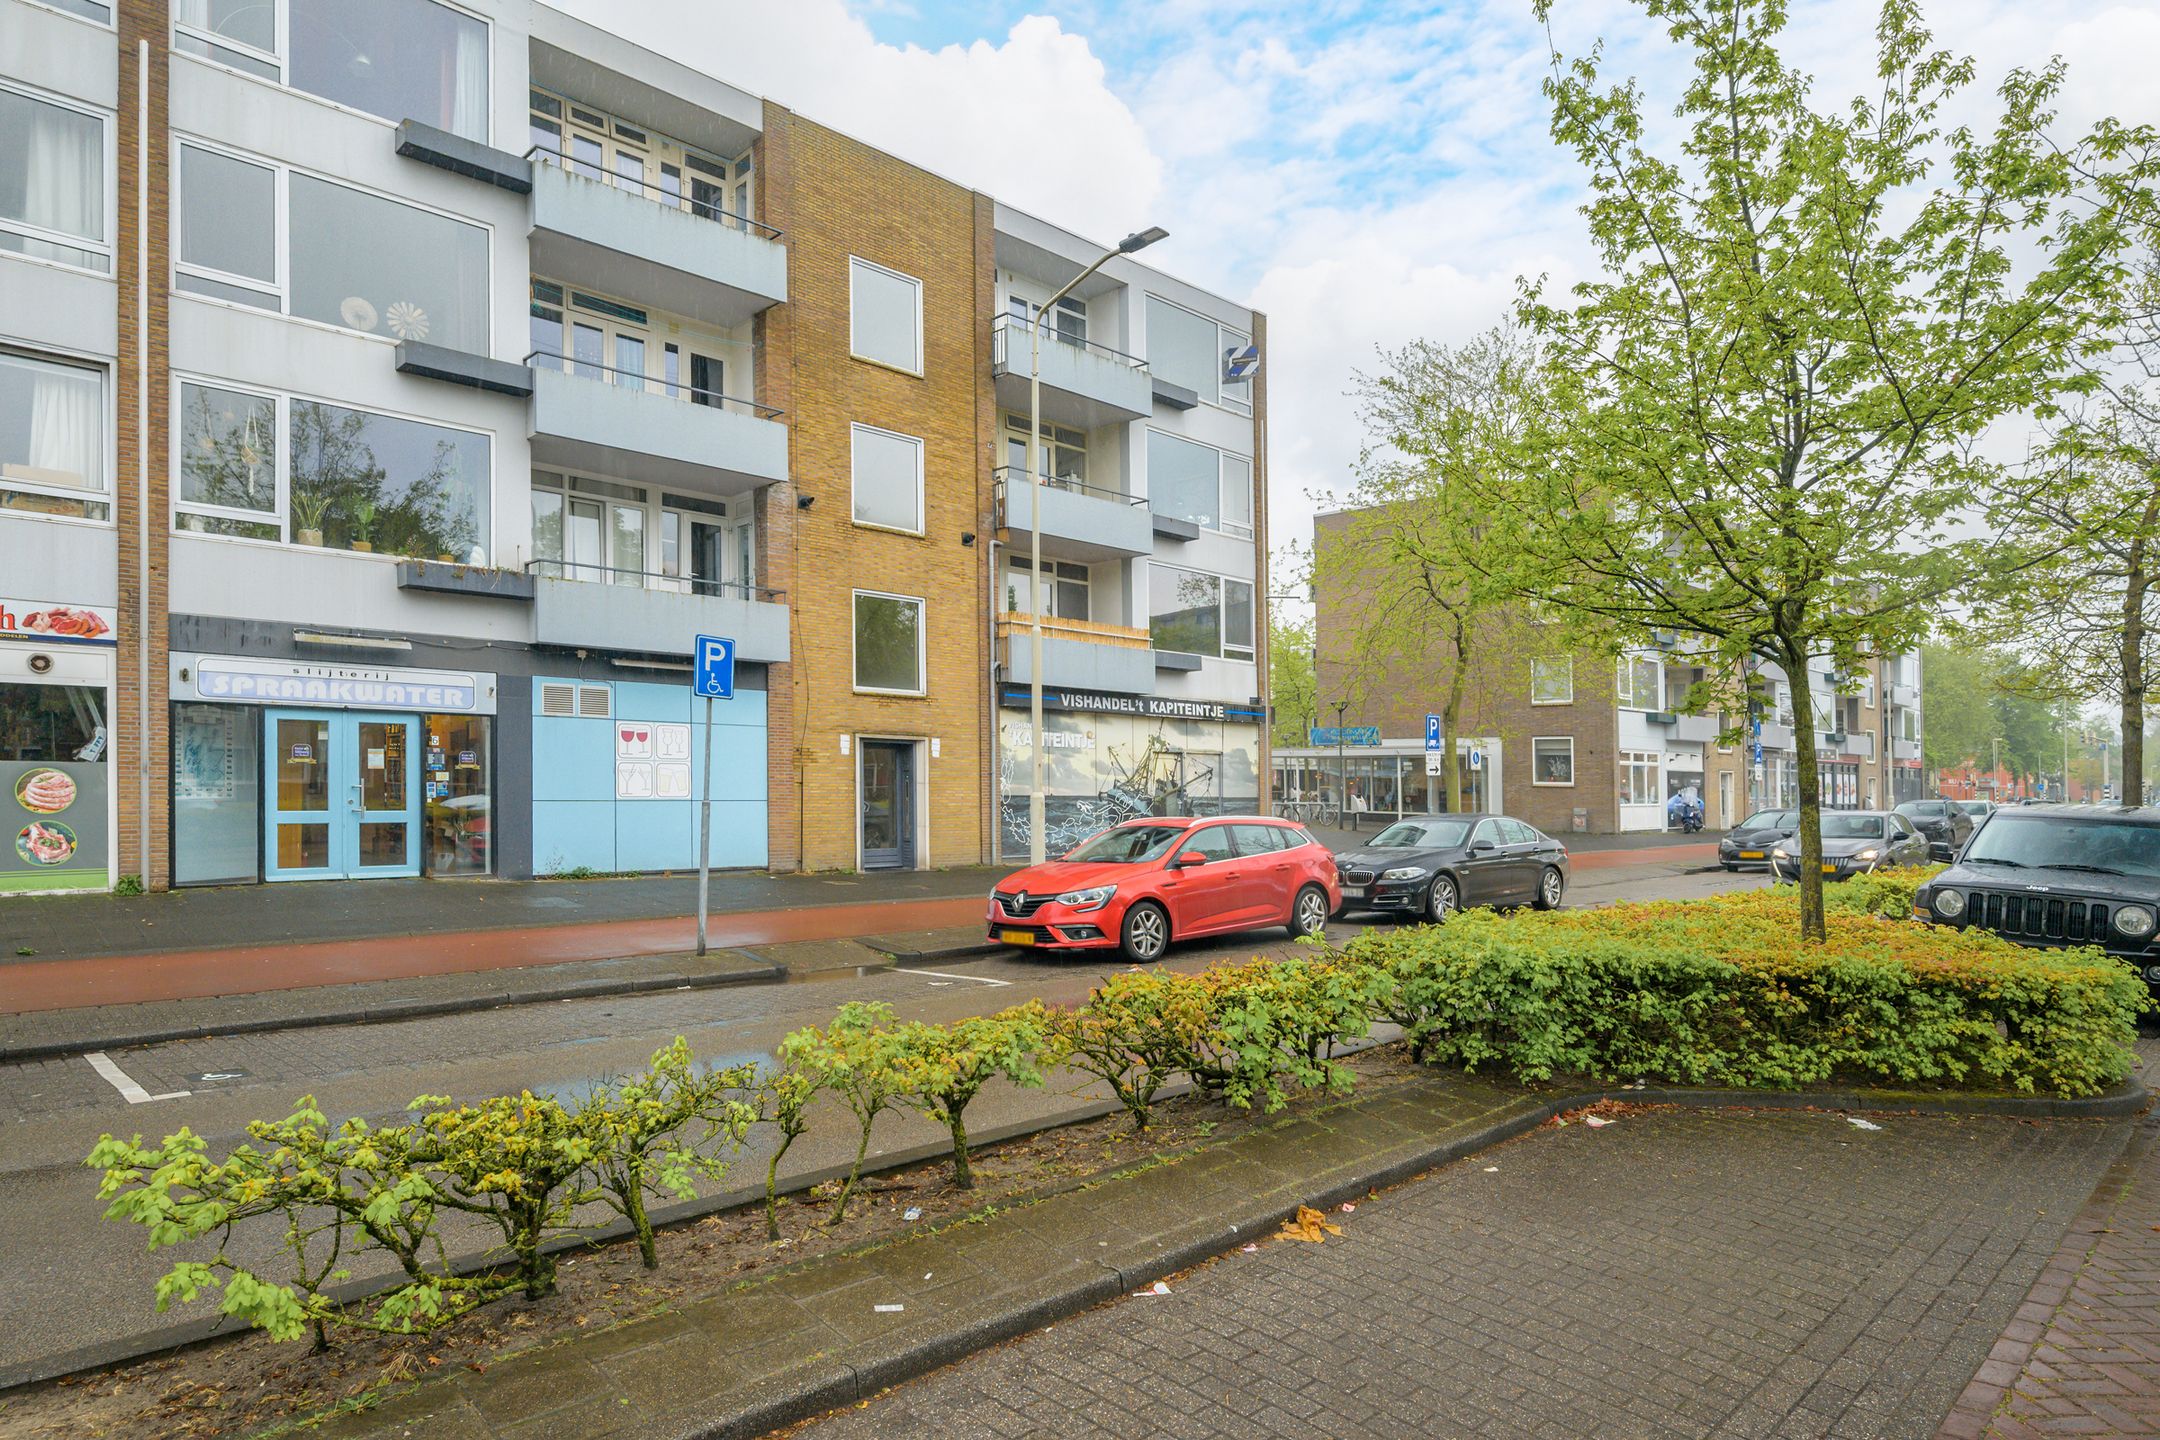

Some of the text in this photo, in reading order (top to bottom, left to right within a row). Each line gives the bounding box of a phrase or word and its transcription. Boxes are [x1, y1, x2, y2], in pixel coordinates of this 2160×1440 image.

[705, 641, 726, 671] P
[292, 667, 390, 681] slijterij
[212, 674, 464, 707] SPRAAKWATER
[1150, 700, 1225, 718] KAPITEINTJE
[1430, 719, 1437, 736] P
[432, 736, 438, 745] 6
